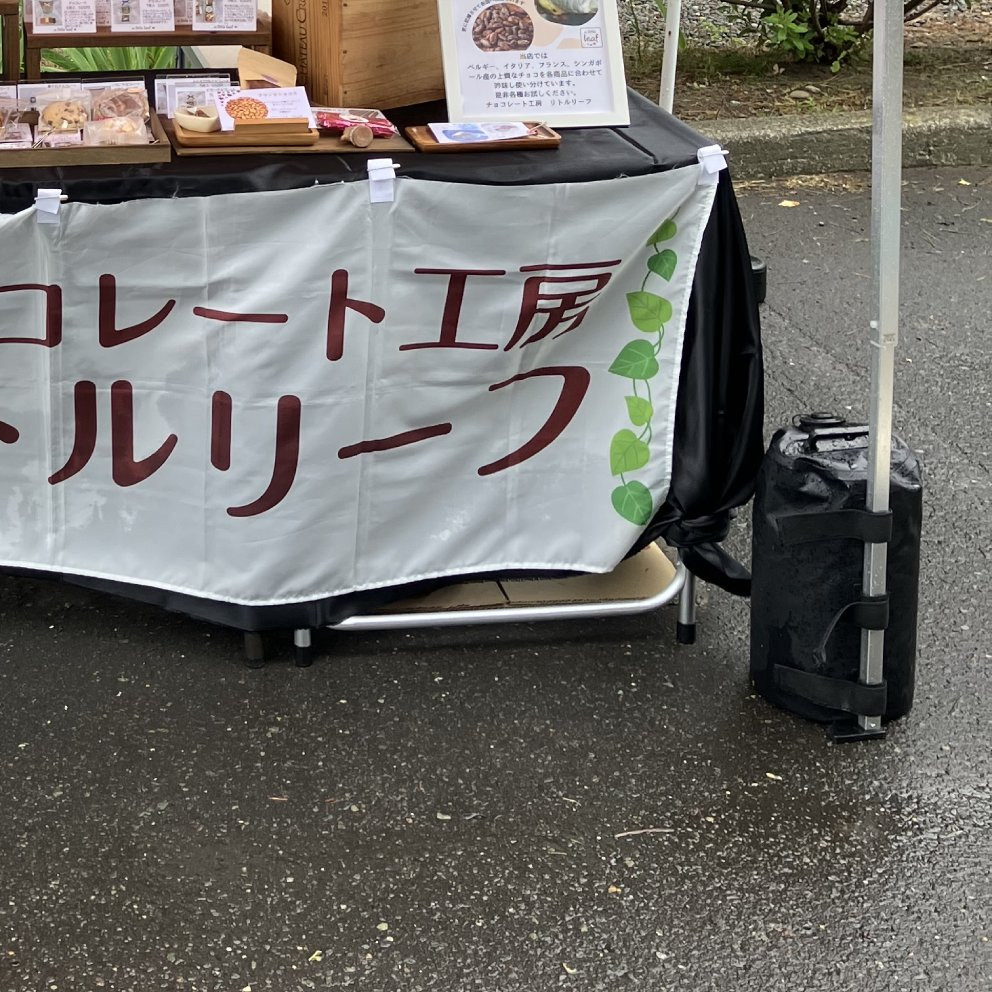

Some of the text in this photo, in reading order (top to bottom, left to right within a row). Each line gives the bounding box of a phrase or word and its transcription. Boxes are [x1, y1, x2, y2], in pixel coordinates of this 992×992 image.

[519, 52, 549, 60] 当店では
[486, 97, 592, 108] チョコレート工房 リトルリーフ
